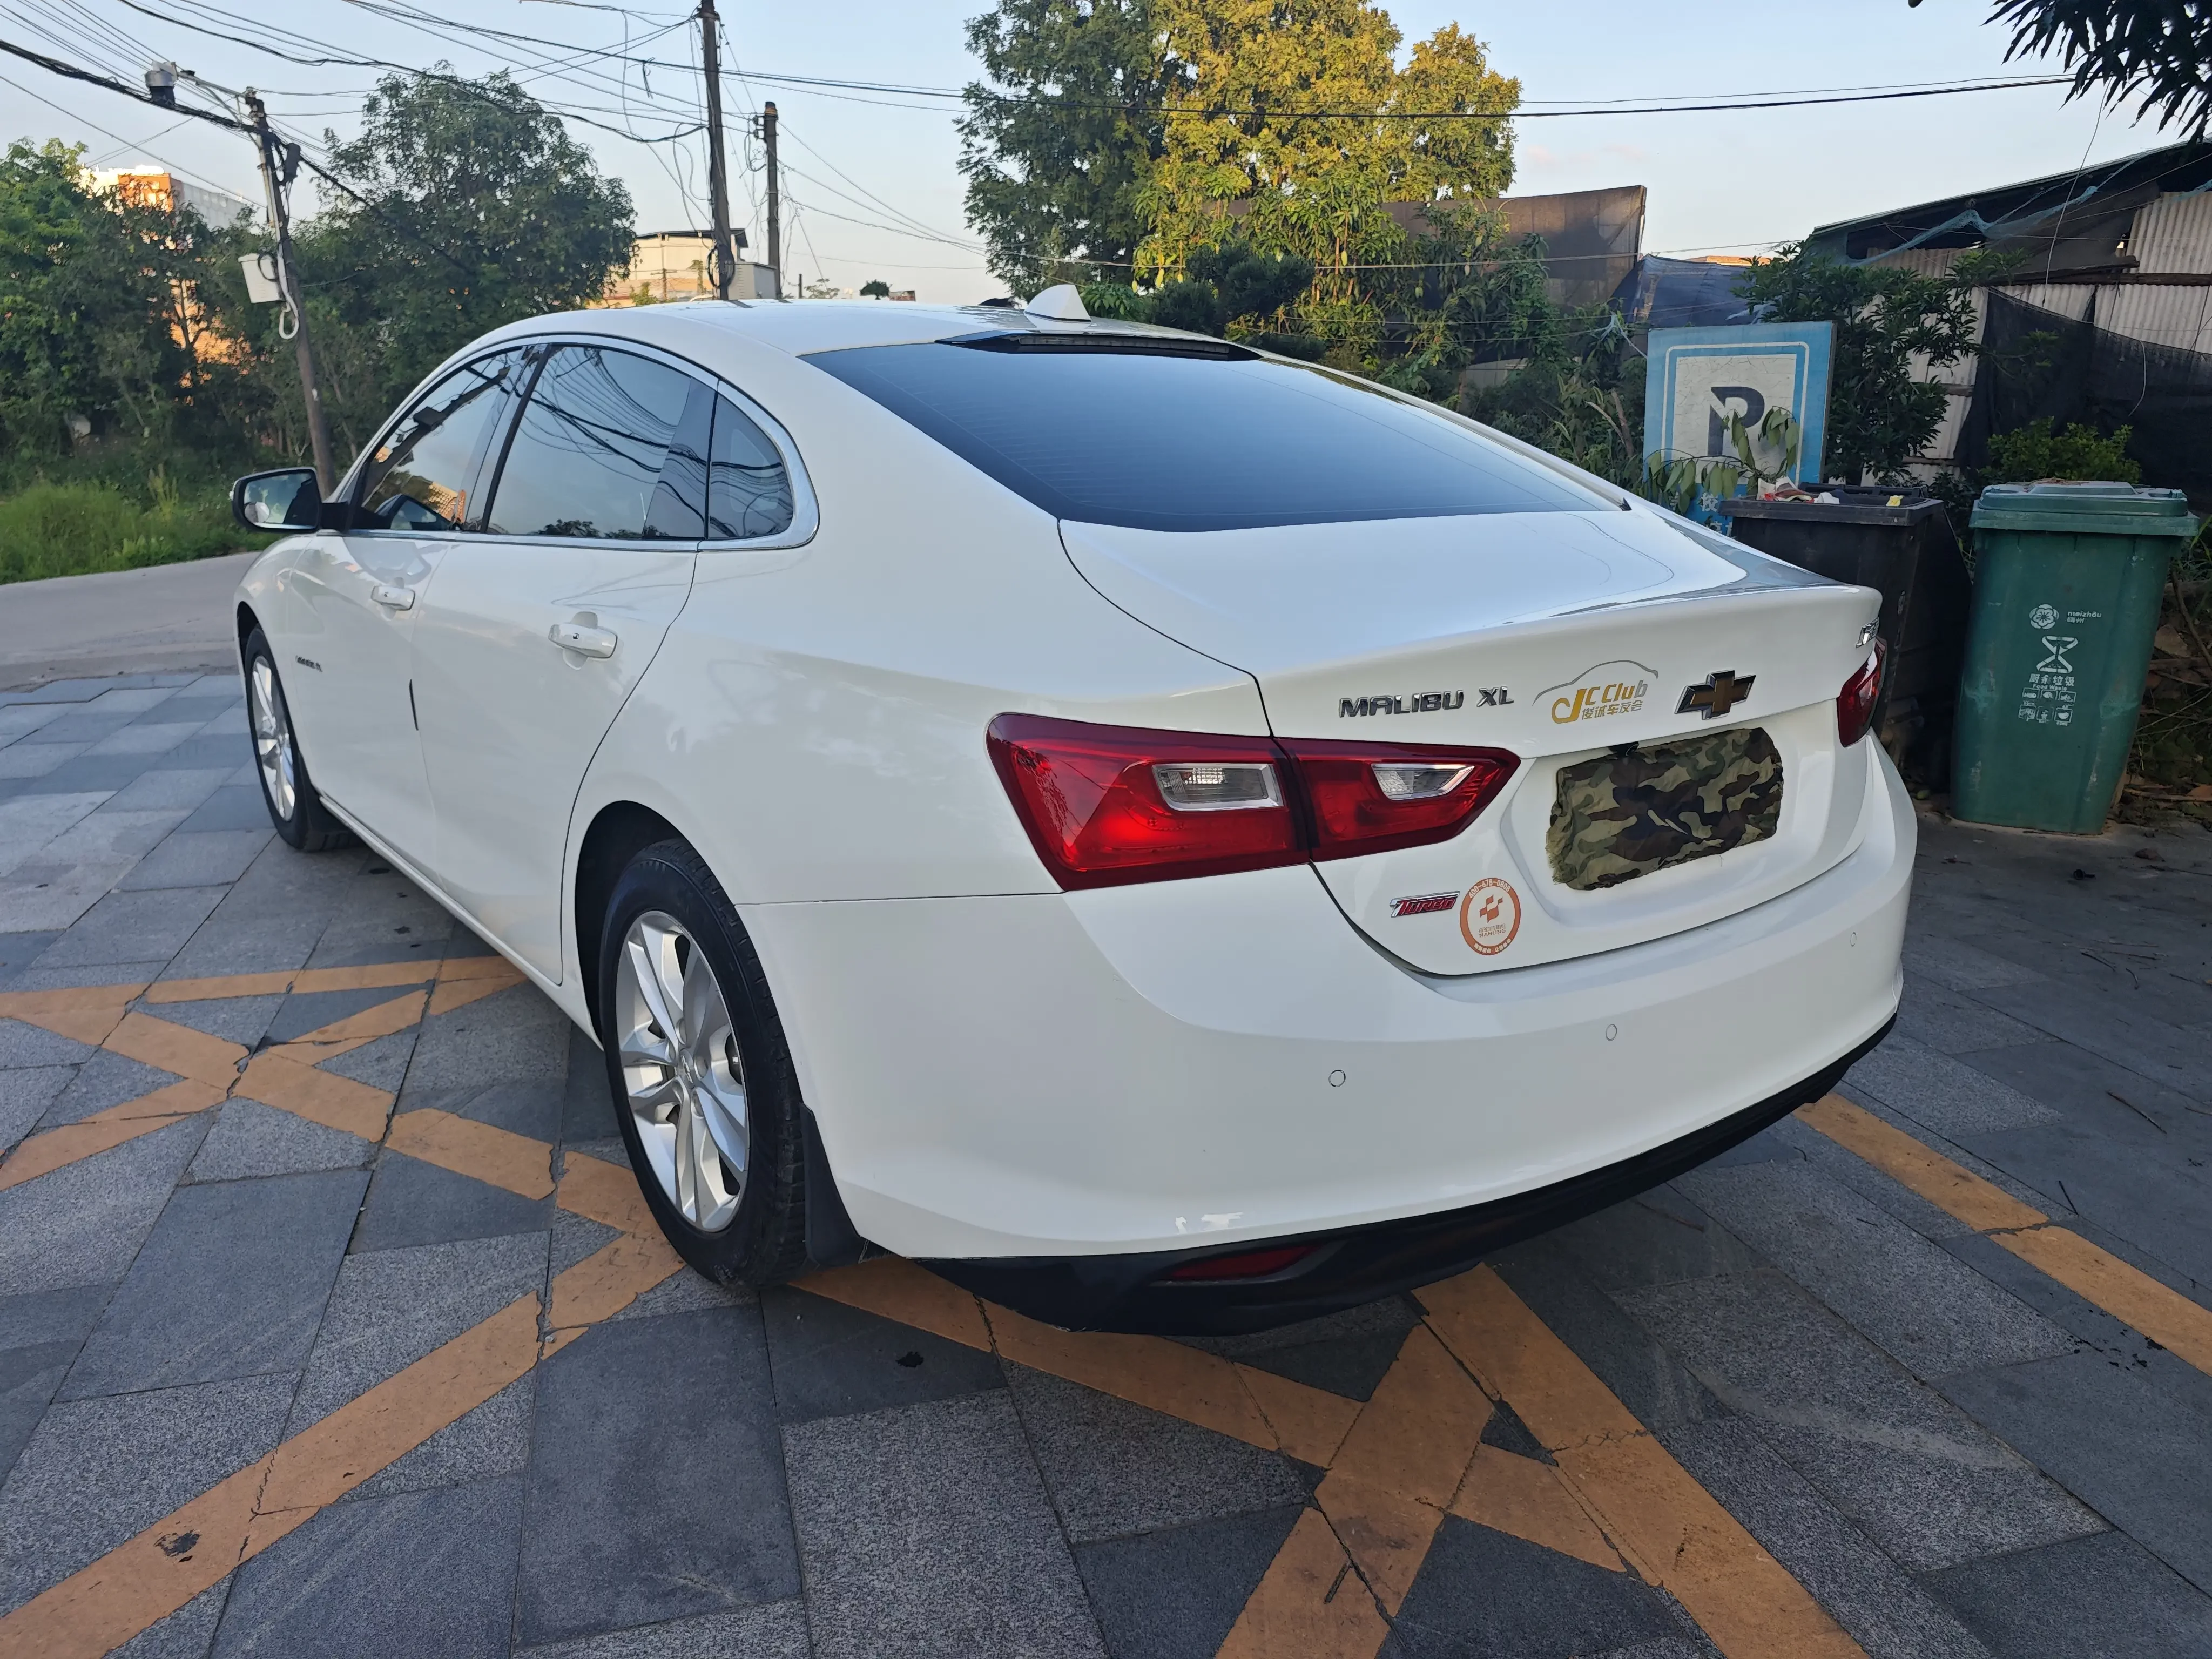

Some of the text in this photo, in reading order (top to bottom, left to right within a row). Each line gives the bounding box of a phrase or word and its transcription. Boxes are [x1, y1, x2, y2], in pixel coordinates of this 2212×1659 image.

[1707, 386, 1765, 456] P
[1601, 679, 1648, 703] Club
[2029, 673, 2074, 686] 厨余垃圾
[1339, 686, 1514, 718] MALIBU XL
[1468, 879, 1511, 899] 400-678-0808
